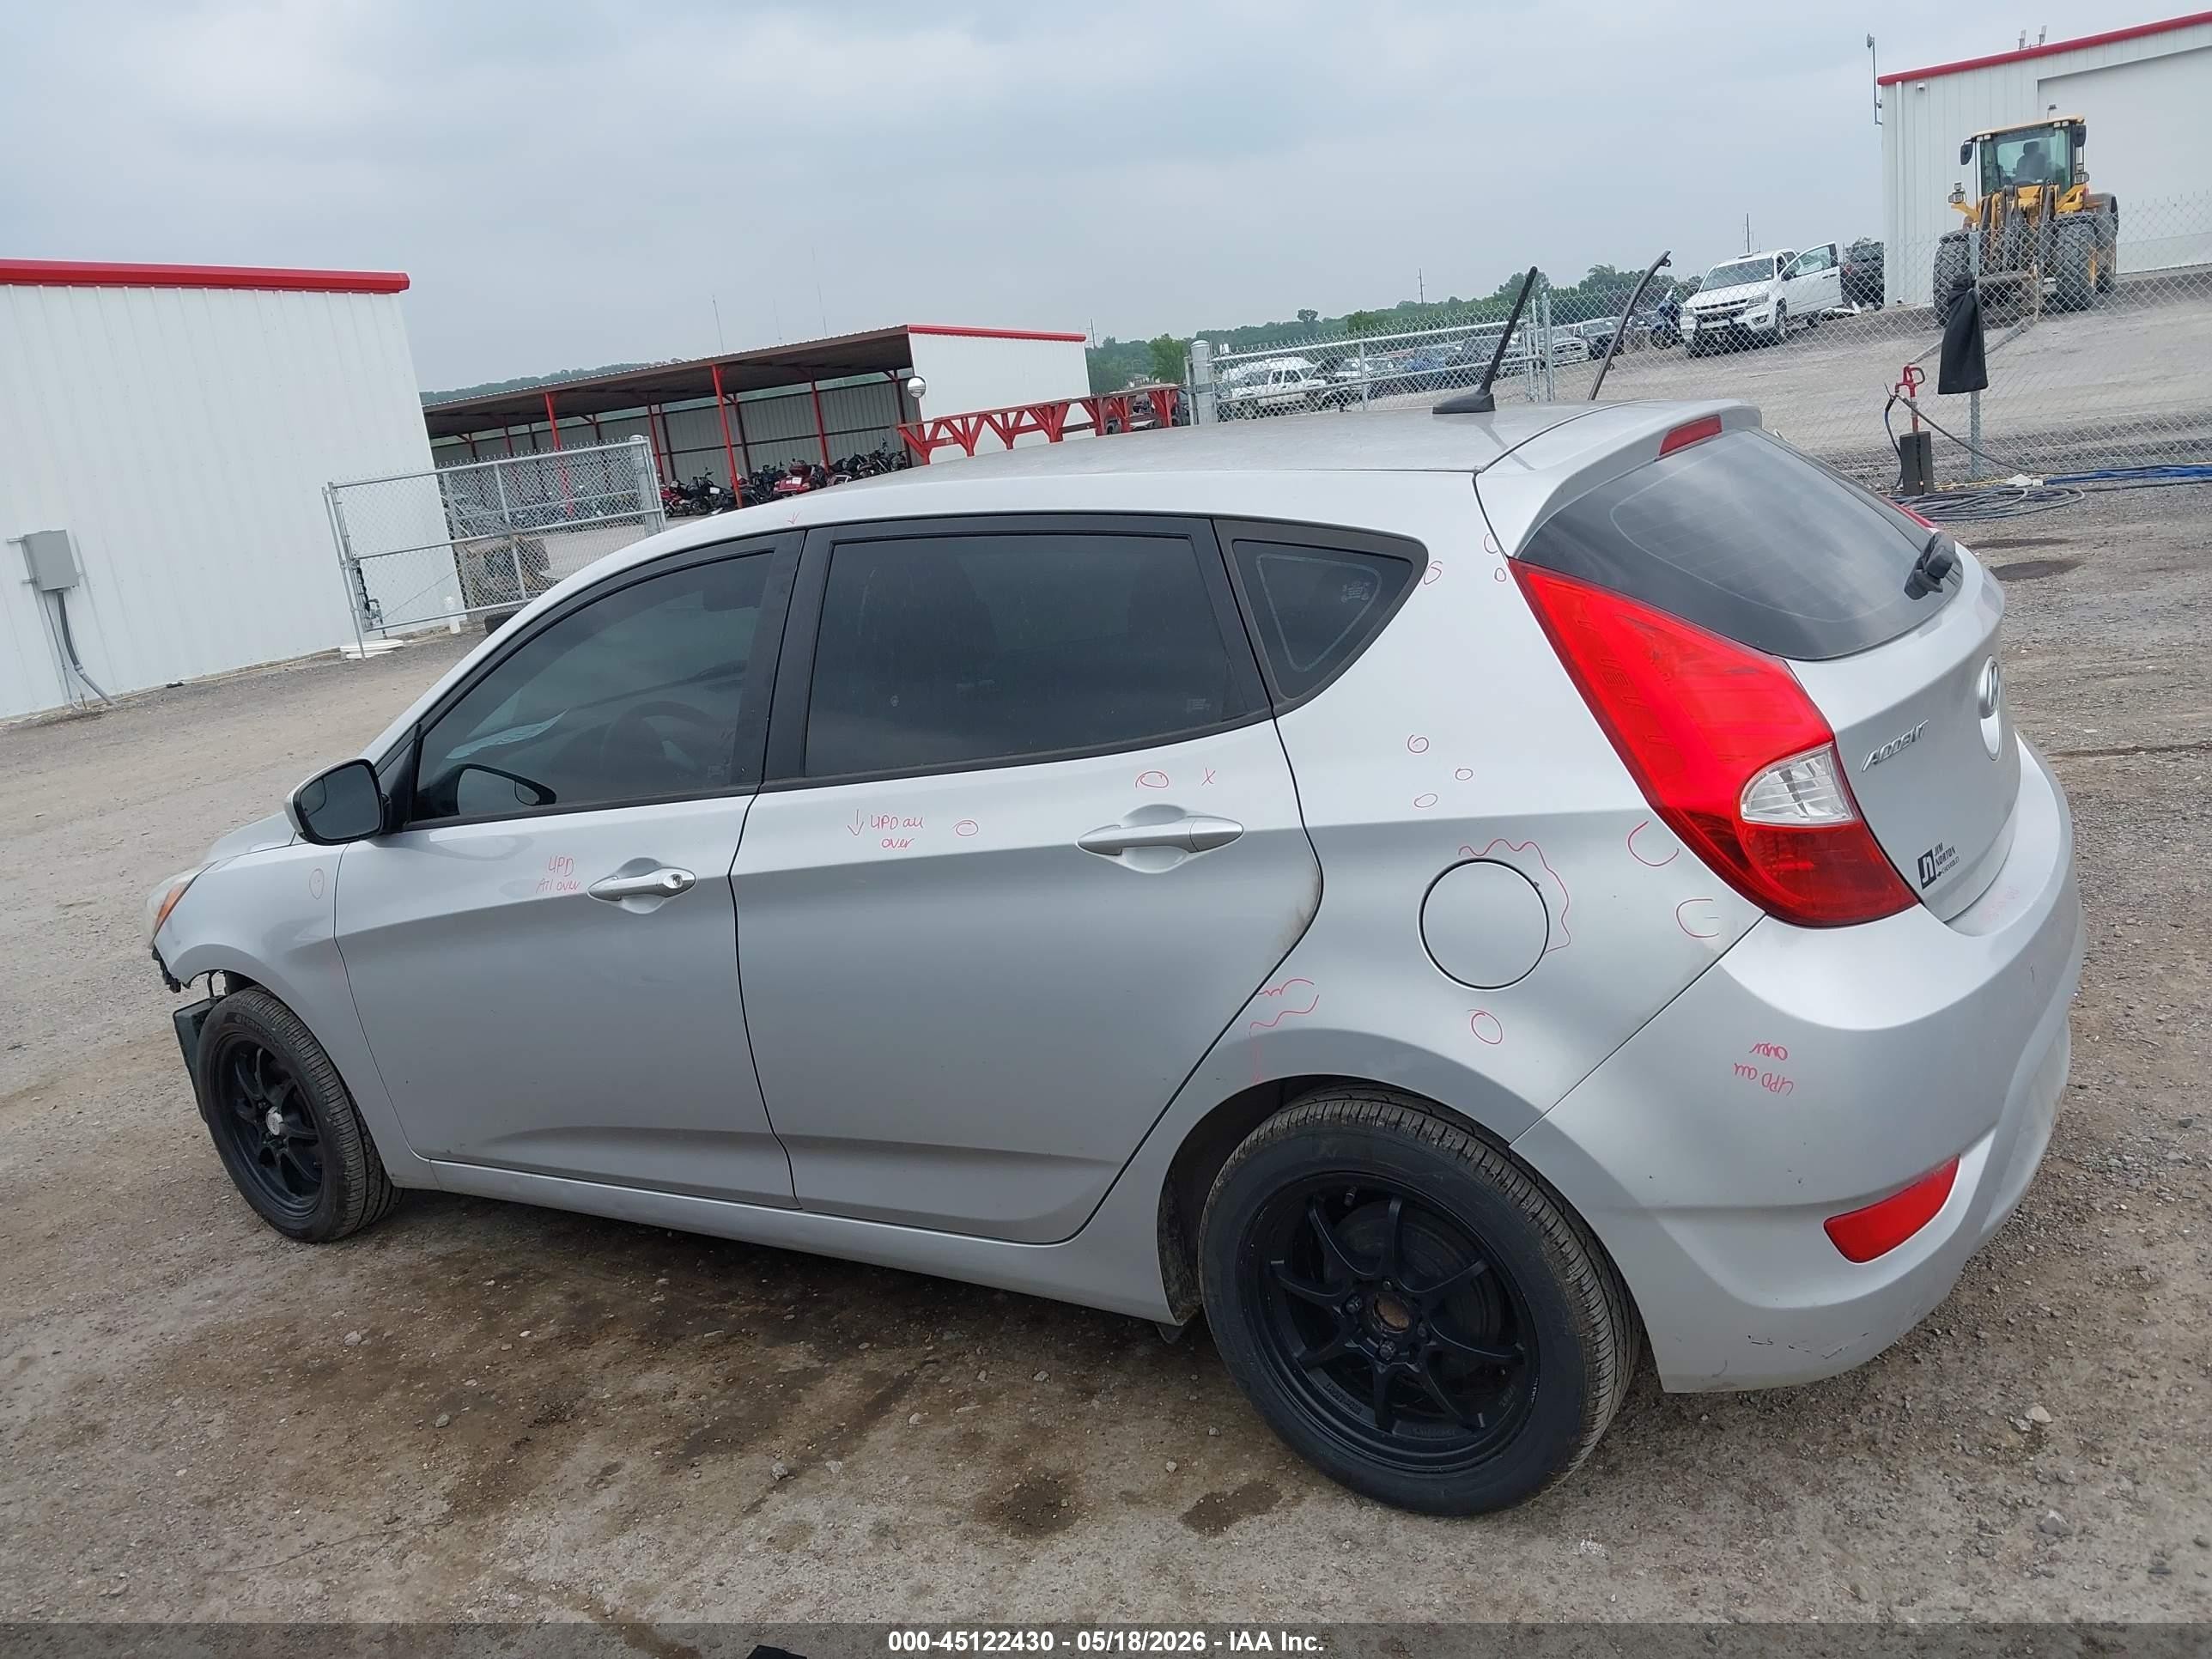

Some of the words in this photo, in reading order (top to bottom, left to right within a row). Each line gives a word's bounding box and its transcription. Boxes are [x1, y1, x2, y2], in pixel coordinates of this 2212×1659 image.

[881, 837, 915, 848] over
[1934, 842, 1943, 857] JIM
[1936, 845, 1956, 866] NORTON
